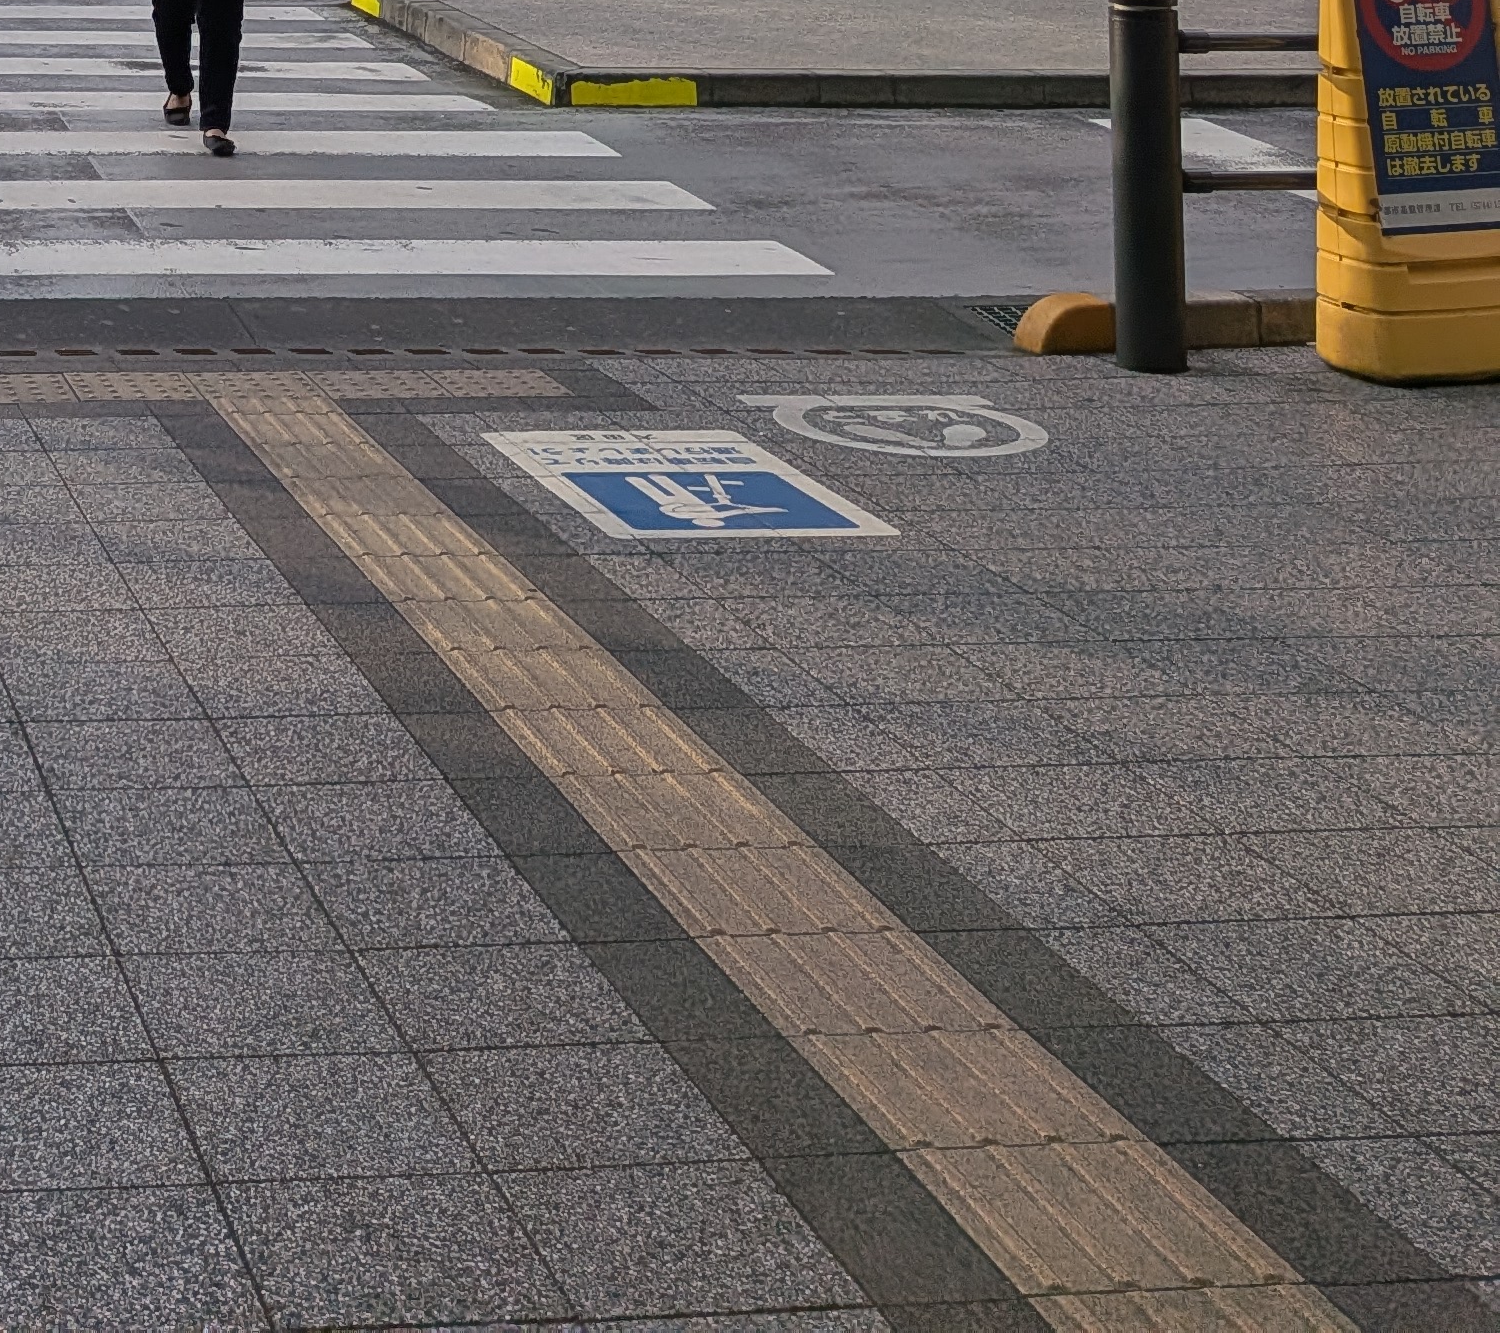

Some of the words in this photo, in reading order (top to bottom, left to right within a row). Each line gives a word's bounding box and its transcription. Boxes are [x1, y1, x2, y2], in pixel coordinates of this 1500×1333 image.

[1399, 2, 1451, 24] 自転車
[1392, 22, 1463, 46] 放置禁止
[1401, 46, 1415, 56] NO
[1418, 44, 1457, 55] PARKING
[1378, 83, 1491, 107] 放置されている
[1384, 129, 1499, 153] 原動機付自転車
[1387, 153, 1481, 176] は撤去します
